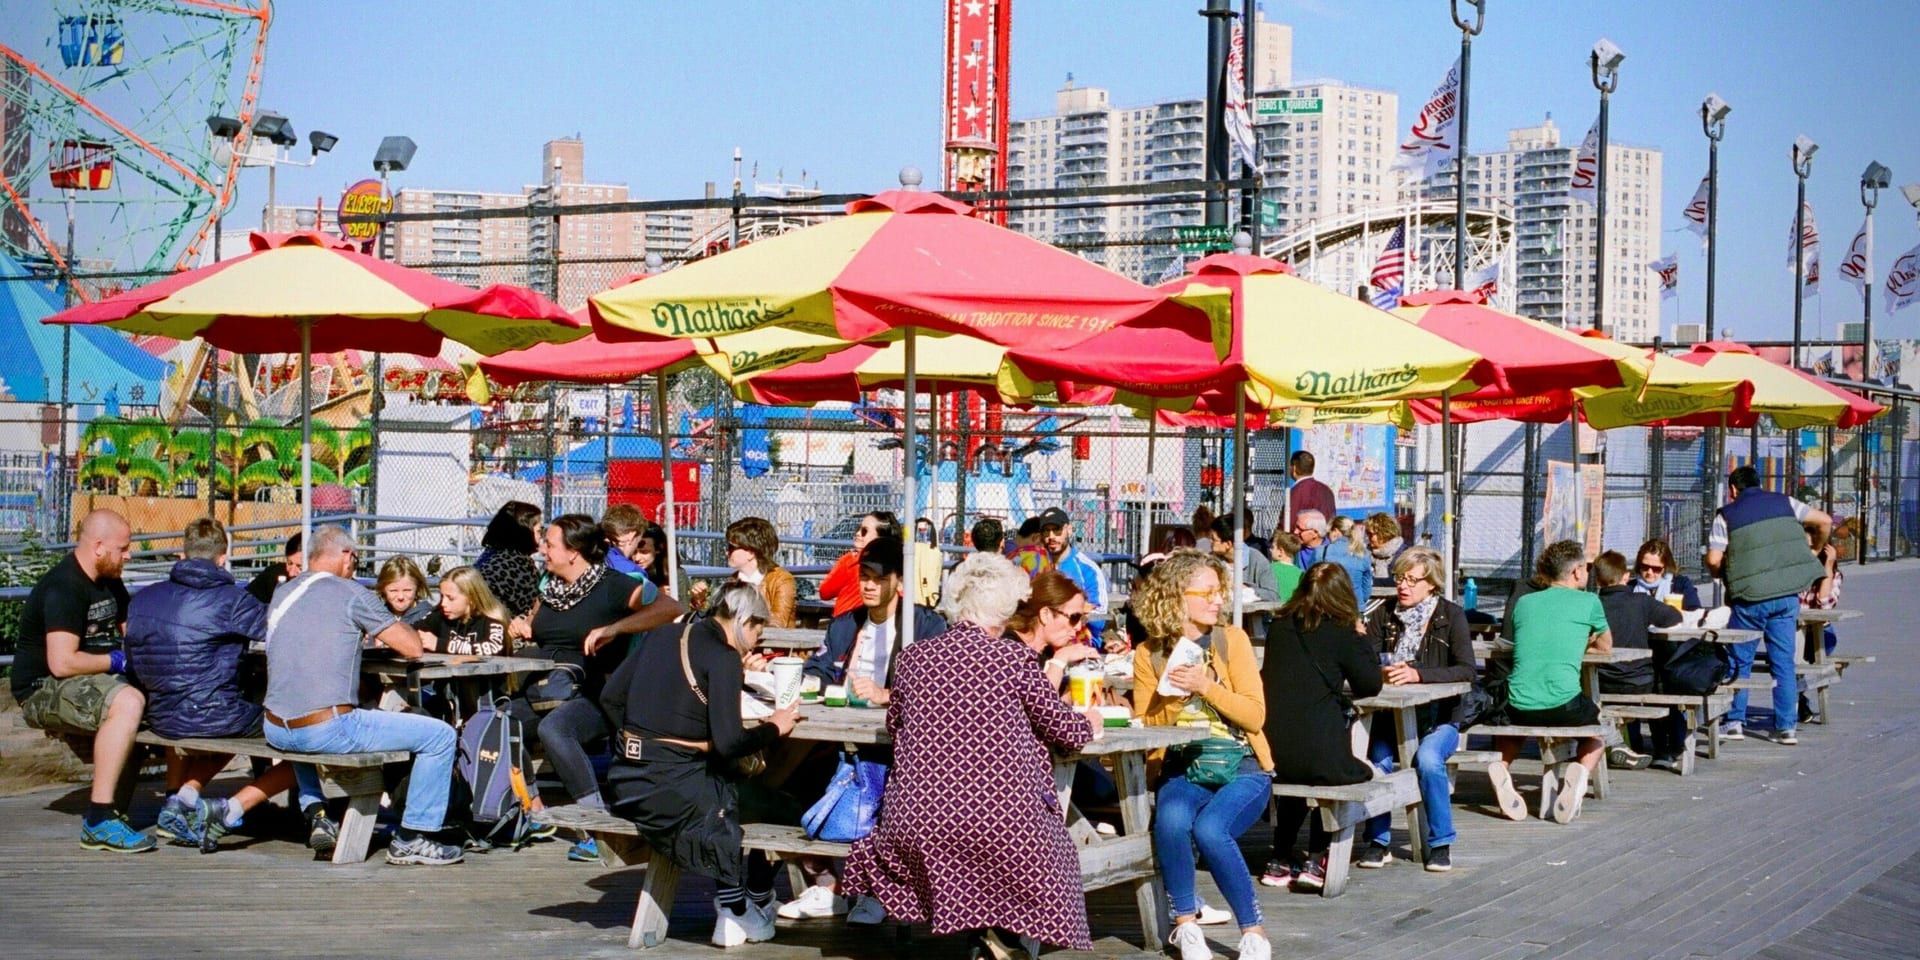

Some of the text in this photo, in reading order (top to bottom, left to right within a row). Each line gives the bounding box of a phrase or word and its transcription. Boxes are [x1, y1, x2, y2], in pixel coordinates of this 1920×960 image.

[344, 193, 393, 215] ELECTO
[970, 312, 1036, 328] TRADITION
[1037, 314, 1079, 329] SINCE
[1296, 363, 1418, 396] Nathan's
[579, 399, 598, 410] EXIT
